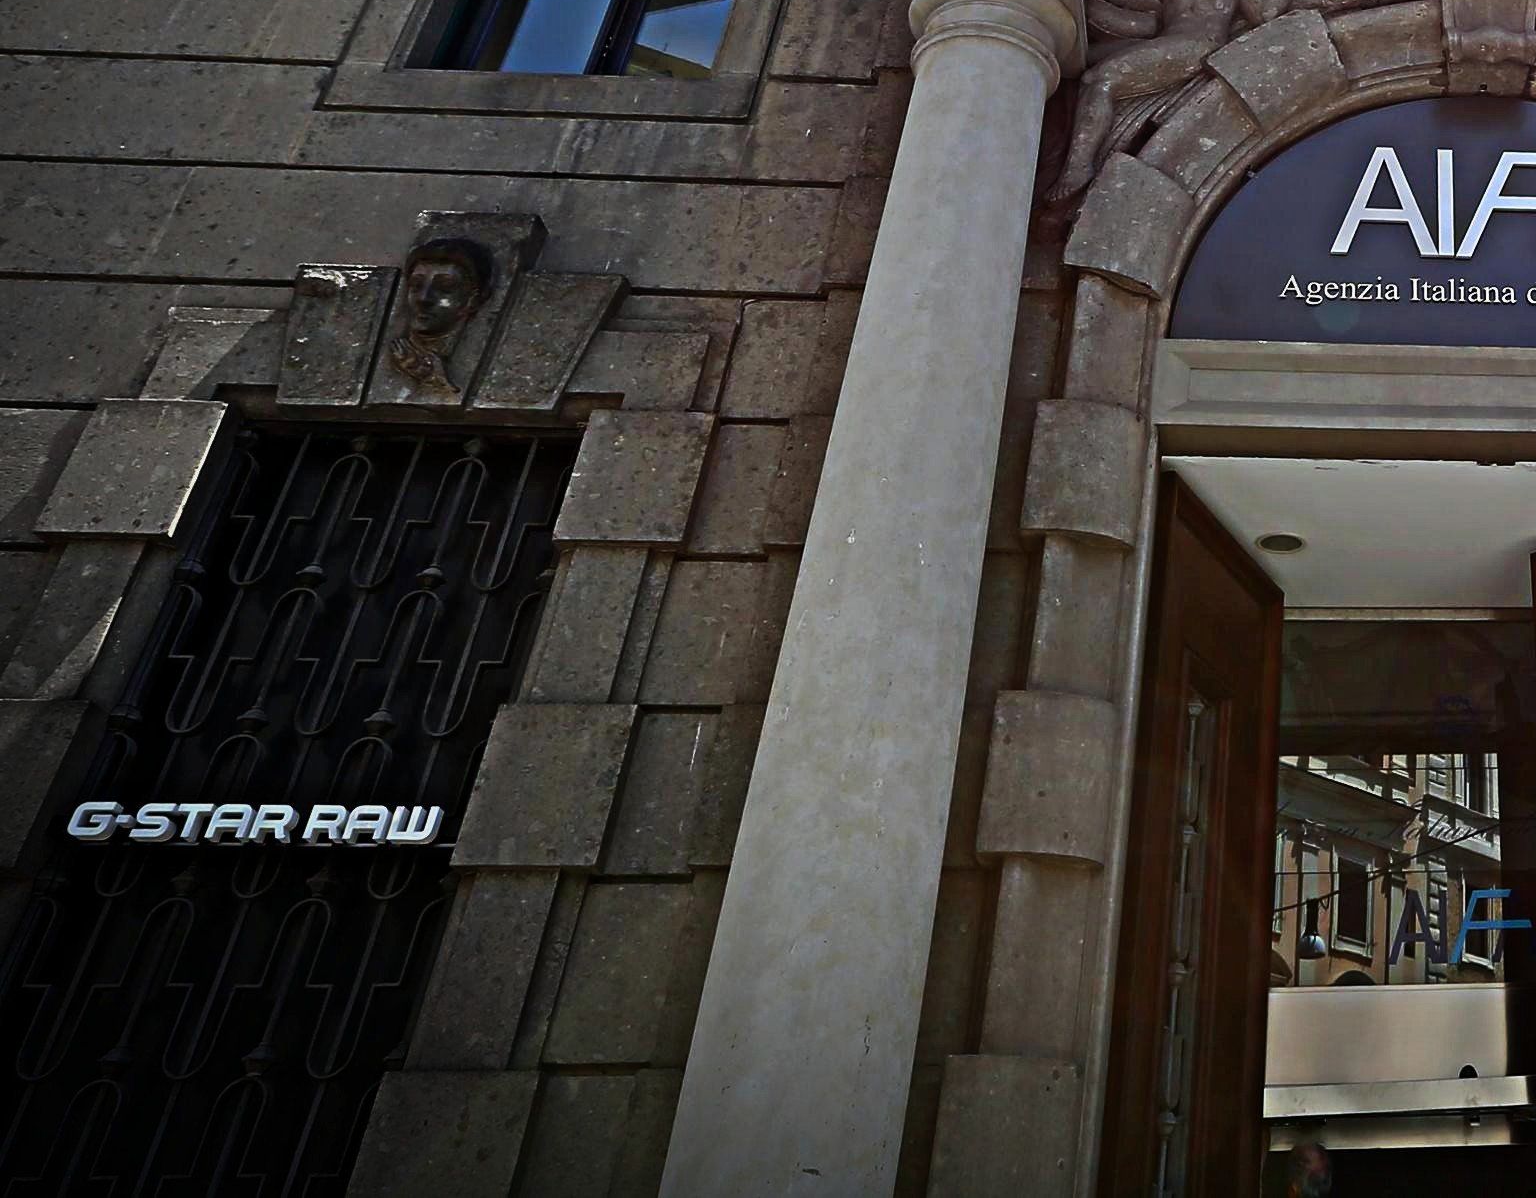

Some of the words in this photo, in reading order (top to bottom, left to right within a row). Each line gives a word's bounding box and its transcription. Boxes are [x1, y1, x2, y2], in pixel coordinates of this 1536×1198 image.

[1279, 274, 1401, 305] Agenzia
[1409, 277, 1518, 304] Italiana
[66, 801, 300, 844] G-STAR
[302, 803, 446, 845] RAW
